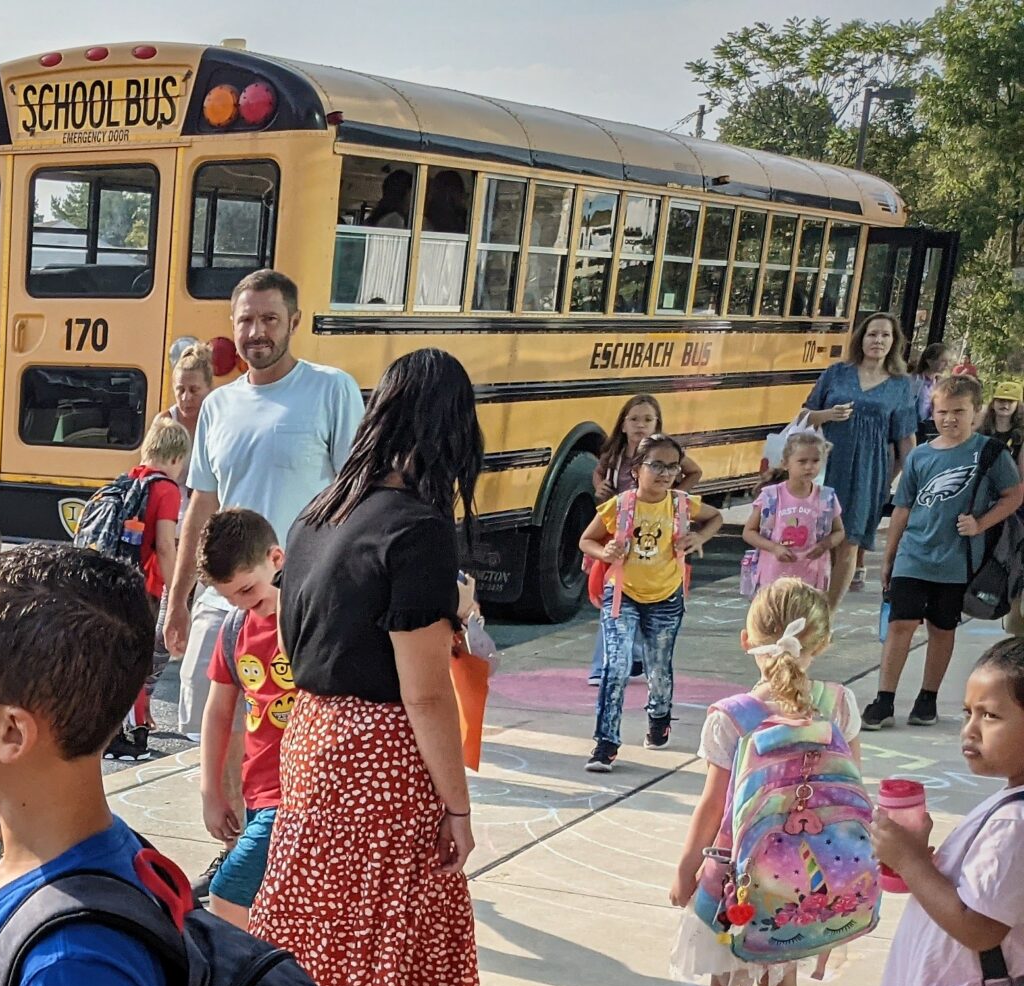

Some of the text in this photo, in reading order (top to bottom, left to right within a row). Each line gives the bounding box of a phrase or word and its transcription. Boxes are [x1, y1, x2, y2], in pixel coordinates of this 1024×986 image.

[22, 76, 177, 132] SCHOOL BUS
[62, 130, 130, 144] EMERGENCY DOOR
[64, 317, 109, 353] 170
[589, 341, 713, 370] ESCHBACH BUS
[802, 340, 817, 364] 170
